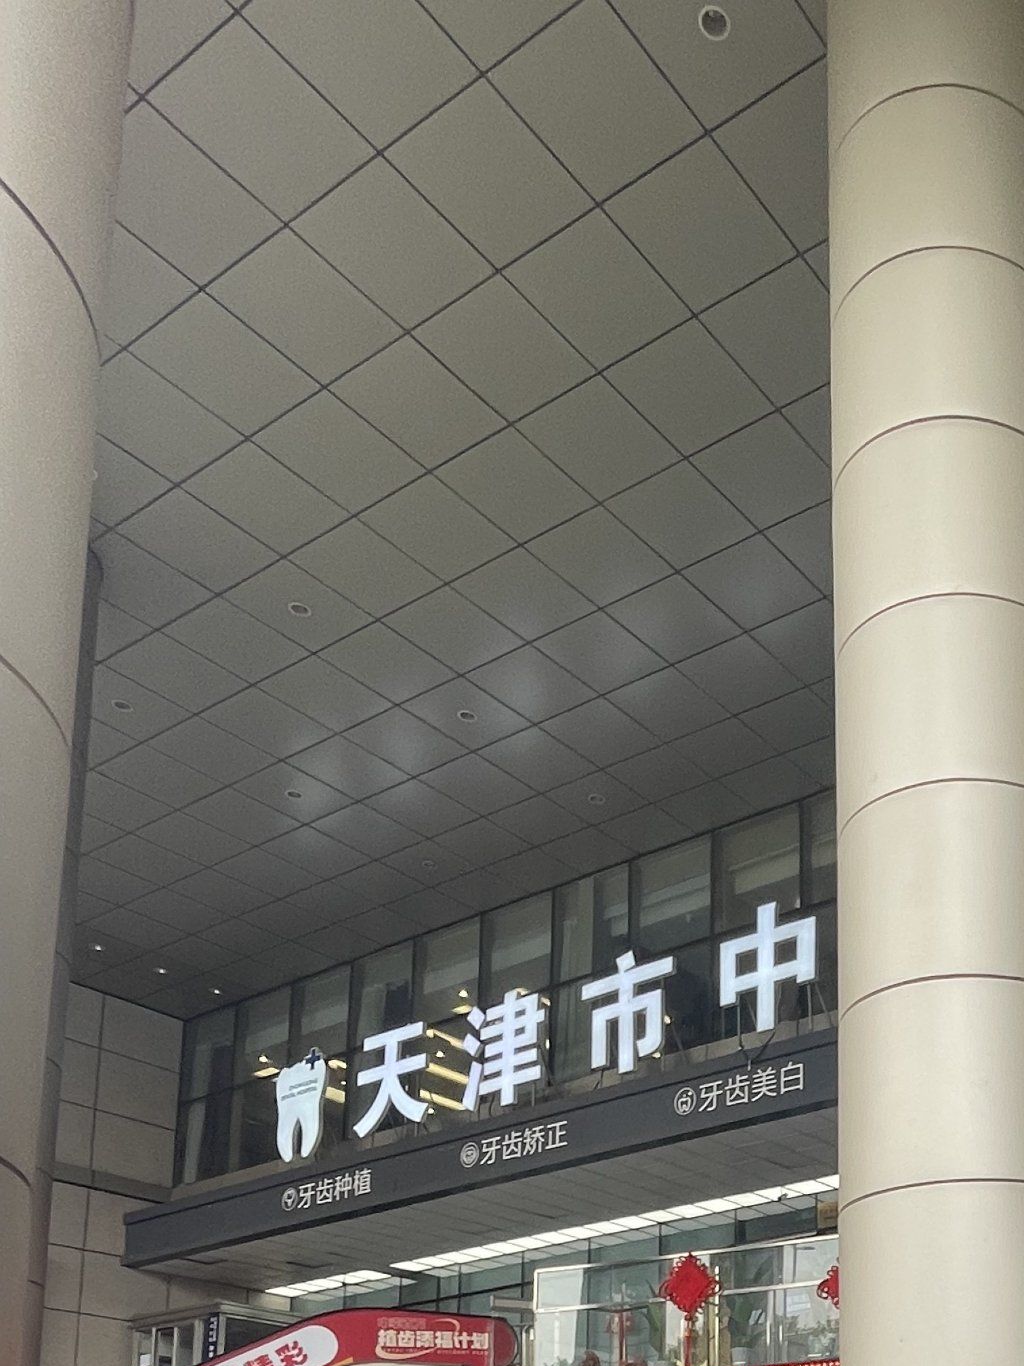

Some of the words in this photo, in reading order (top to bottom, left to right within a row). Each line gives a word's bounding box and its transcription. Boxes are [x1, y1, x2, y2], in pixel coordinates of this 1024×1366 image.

[698, 1061, 805, 1112] 牙齿美白
[480, 1121, 568, 1165] 牙齿矫正
[297, 1168, 372, 1209] 牙齿种植
